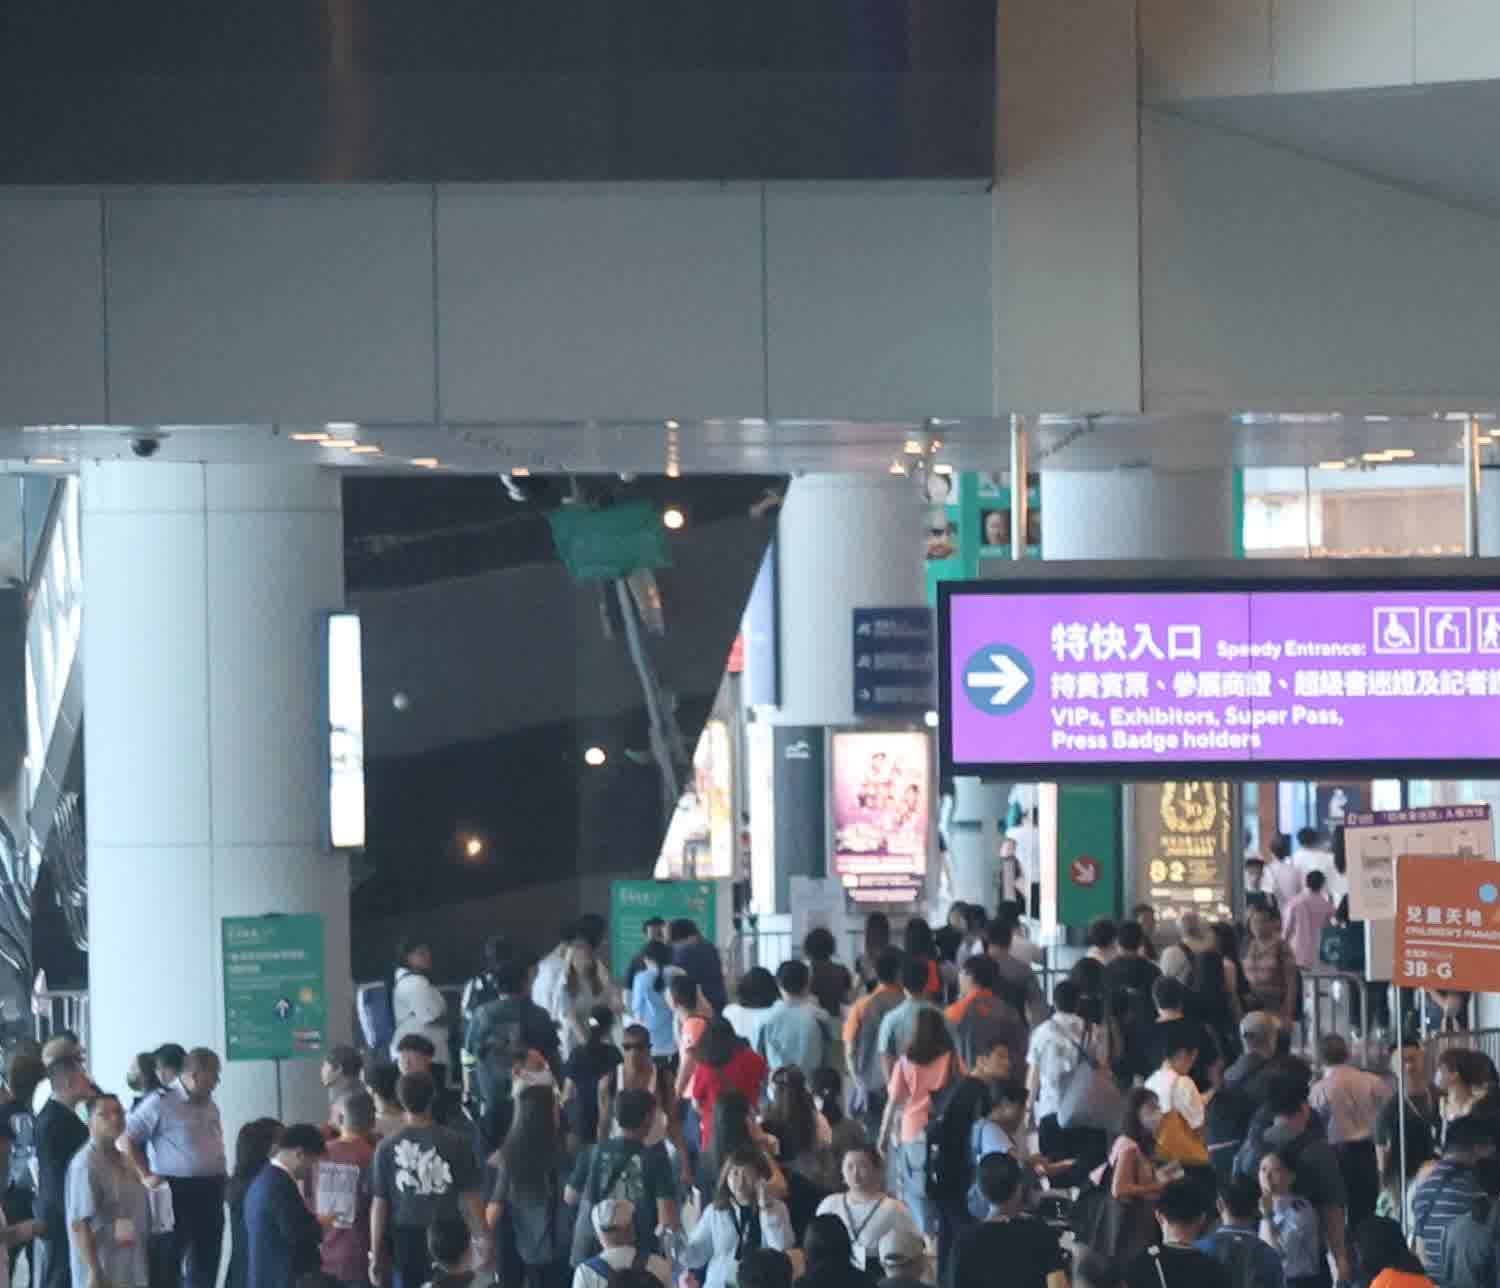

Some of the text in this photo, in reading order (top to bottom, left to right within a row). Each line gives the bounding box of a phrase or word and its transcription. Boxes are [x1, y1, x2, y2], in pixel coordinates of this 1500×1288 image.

[1052, 622, 1201, 661] 特快入口
[1216, 640, 1366, 661] Speedy Entrance:
[1051, 704, 1344, 728] VIPs, Exhibitors, Super Pass,
[1052, 729, 1261, 752] Press Badge holders
